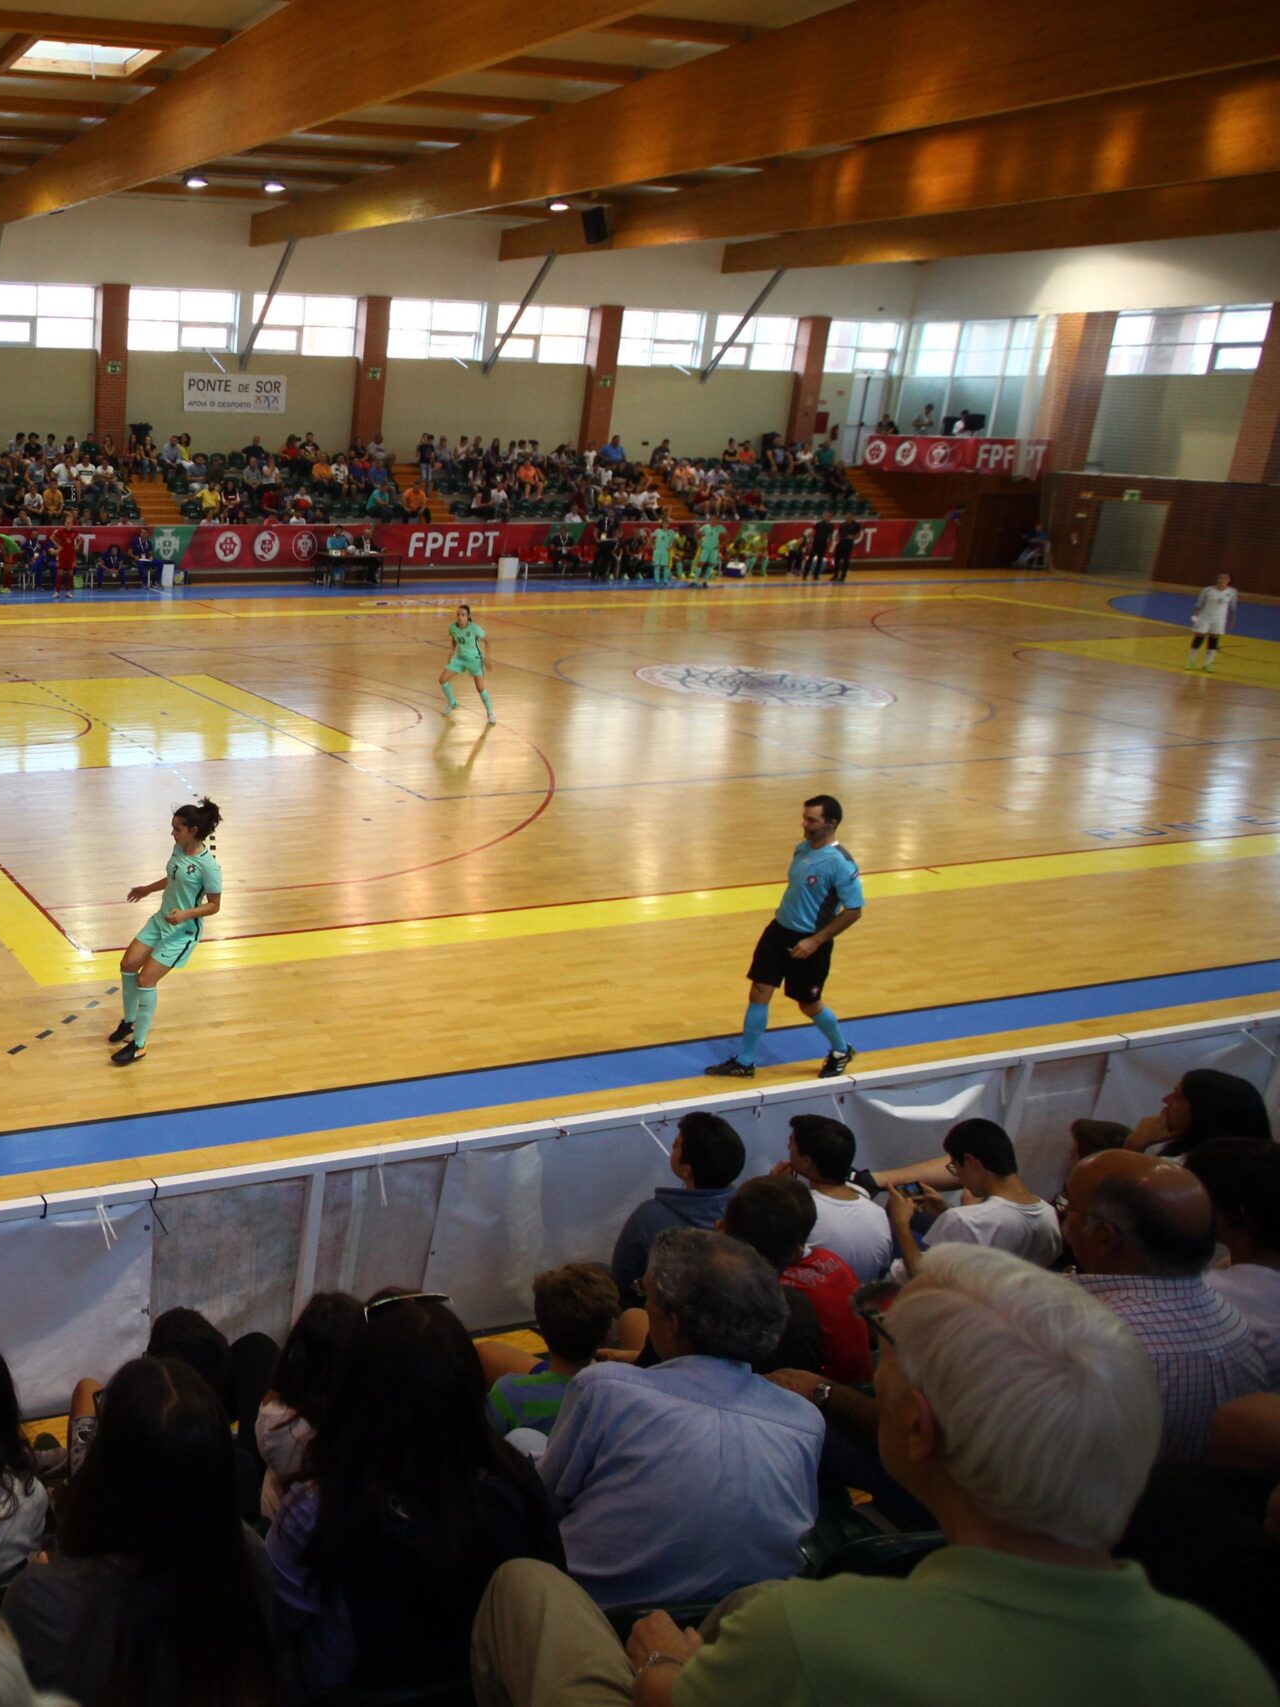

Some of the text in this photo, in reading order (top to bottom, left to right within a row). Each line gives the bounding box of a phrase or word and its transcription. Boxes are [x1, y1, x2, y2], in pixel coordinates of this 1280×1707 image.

[188, 379, 281, 393] PONTE DE SOR
[408, 531, 500, 558] FPF.PT
